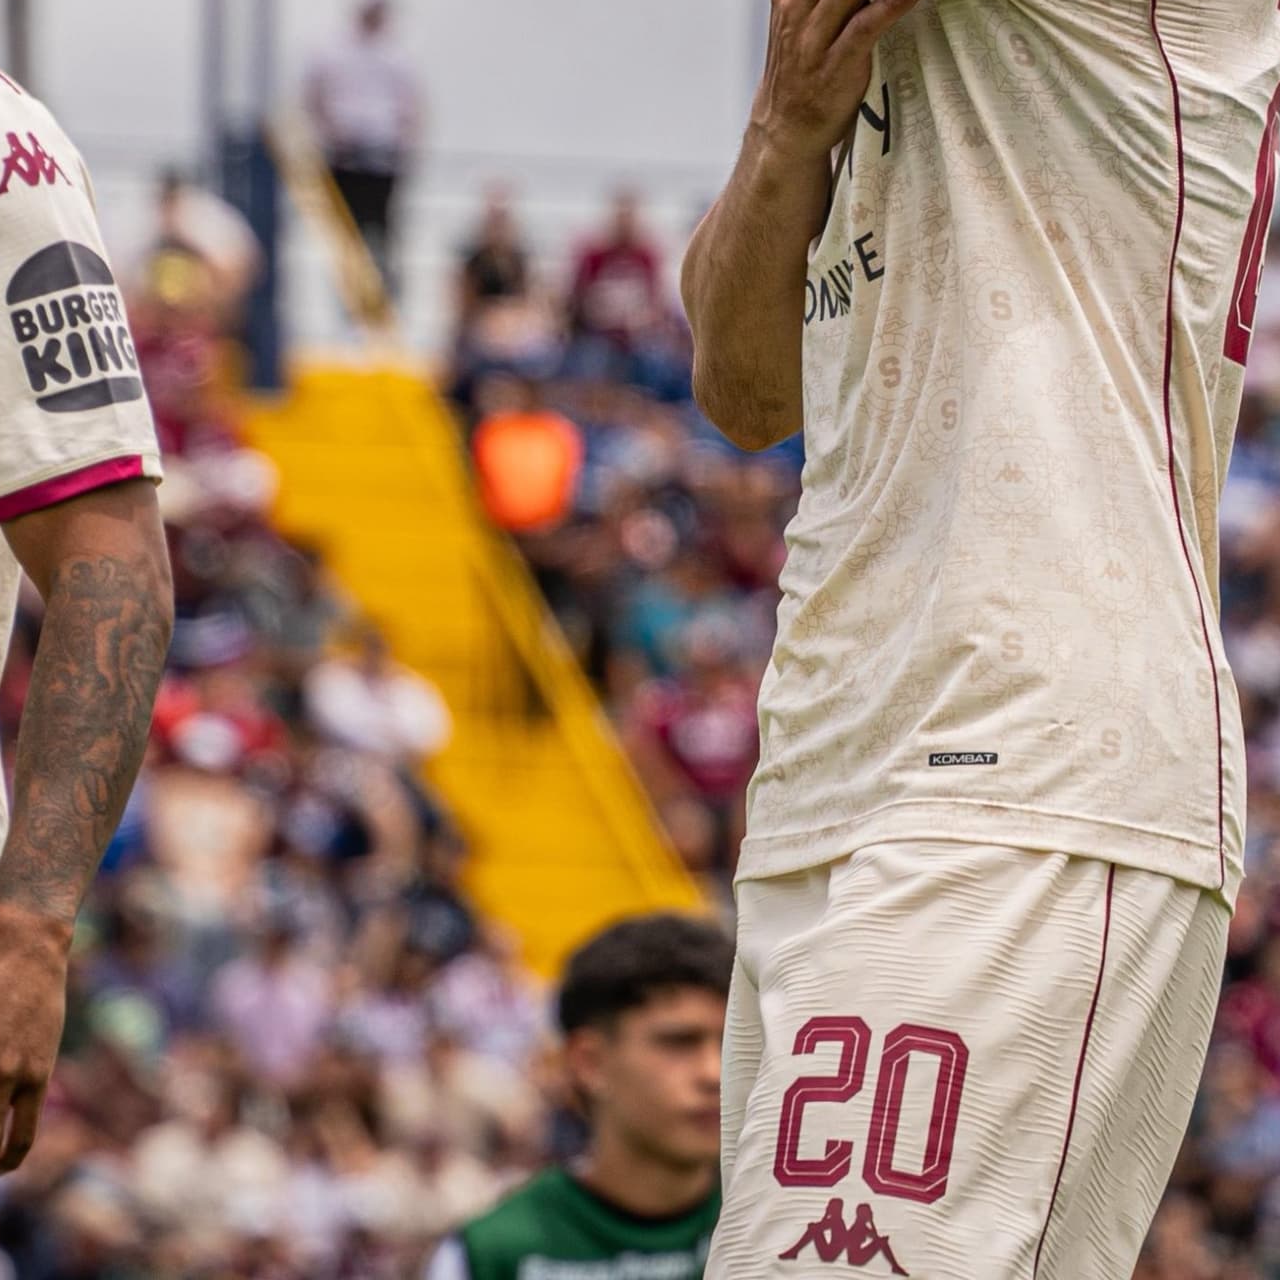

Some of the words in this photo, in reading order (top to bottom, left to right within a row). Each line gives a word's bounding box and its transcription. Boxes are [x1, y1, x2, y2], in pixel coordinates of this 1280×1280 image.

[10, 291, 123, 344] BURGER
[22, 325, 138, 393] KING
[932, 754, 994, 765] KOMBAT
[773, 1015, 970, 1205] 20
